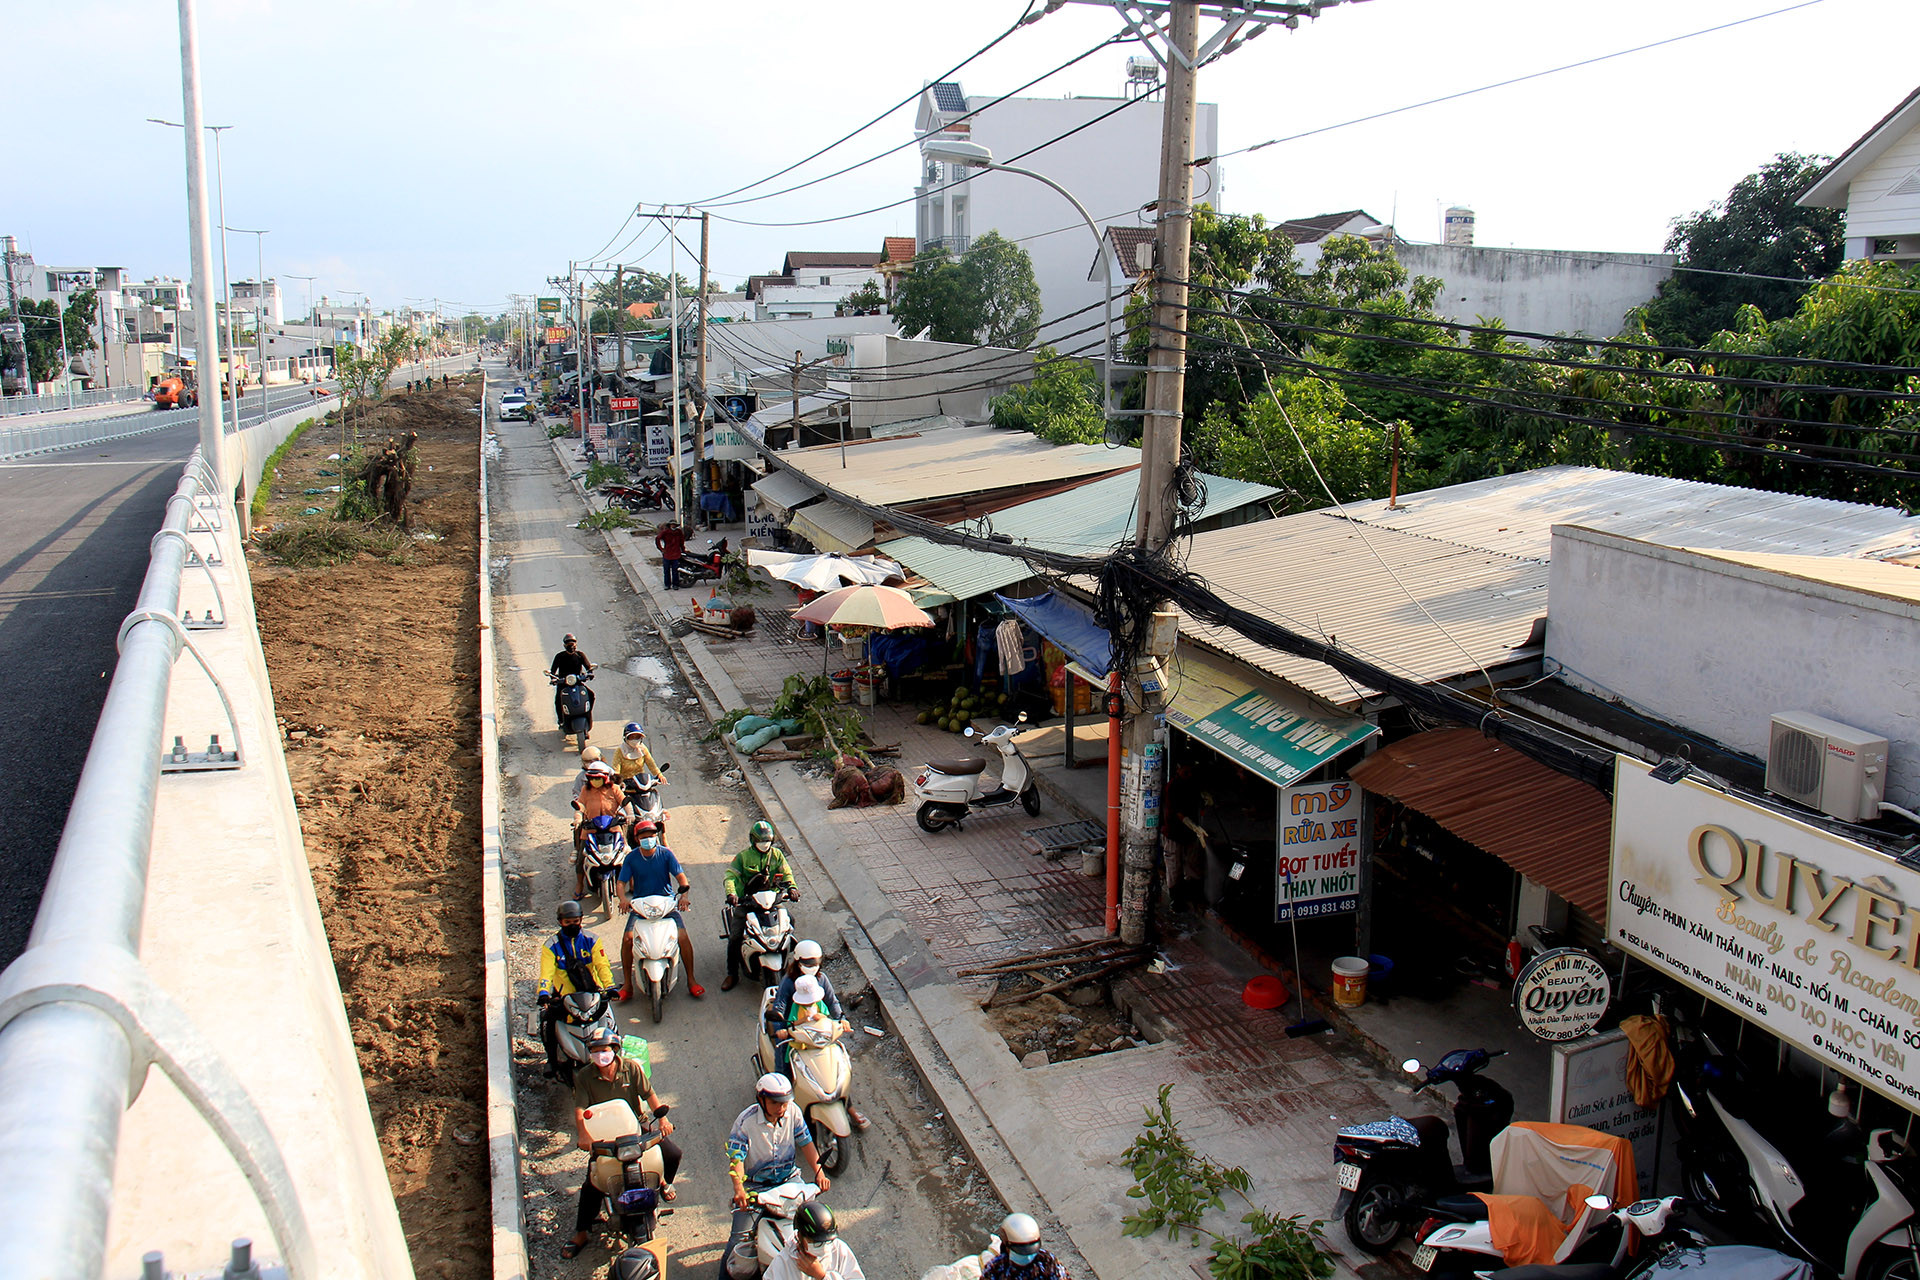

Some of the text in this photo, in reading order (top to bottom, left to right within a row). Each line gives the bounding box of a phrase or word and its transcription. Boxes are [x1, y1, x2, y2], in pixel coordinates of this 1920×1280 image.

[1827, 744, 1856, 757] SHARP
[1284, 818, 1358, 846] RỬA XE
[1279, 842, 1358, 879] BỌT TUYẾT
[1282, 870, 1357, 900] THAY NHỚT
[1298, 904, 1319, 917] 0919
[1322, 902, 1337, 914] 831
[1340, 900, 1356, 911] 483
[1716, 897, 1786, 955] Beauty
[1794, 939, 1818, 966] &
[1619, 880, 1660, 916] Chuyên:
[1662, 908, 1687, 931] PHUN
[1688, 920, 1714, 944] XĂM
[1716, 936, 1744, 960] THẨM
[1771, 962, 1802, 989] NAILS
[1810, 982, 1832, 1004] NỐI
[1834, 994, 1849, 1014] MI
[1858, 1008, 1899, 1040] CHĂM
[1547, 975, 1586, 986] BEAUTY
[1650, 944, 1664, 960] Văn
[1736, 992, 1753, 1008] Nhà
[1756, 1002, 1768, 1016] Bè
[1525, 982, 1606, 1015] Quyên
[1535, 1022, 1590, 1040] 0907 980 546
[1725, 962, 1906, 1072] NHẬN ĐÀO TẠO HỌC VIÊN
[1824, 1040, 1856, 1065] Huỳnh
[1858, 1057, 1882, 1078] Thục
[1592, 1098, 1608, 1113] Sóc
